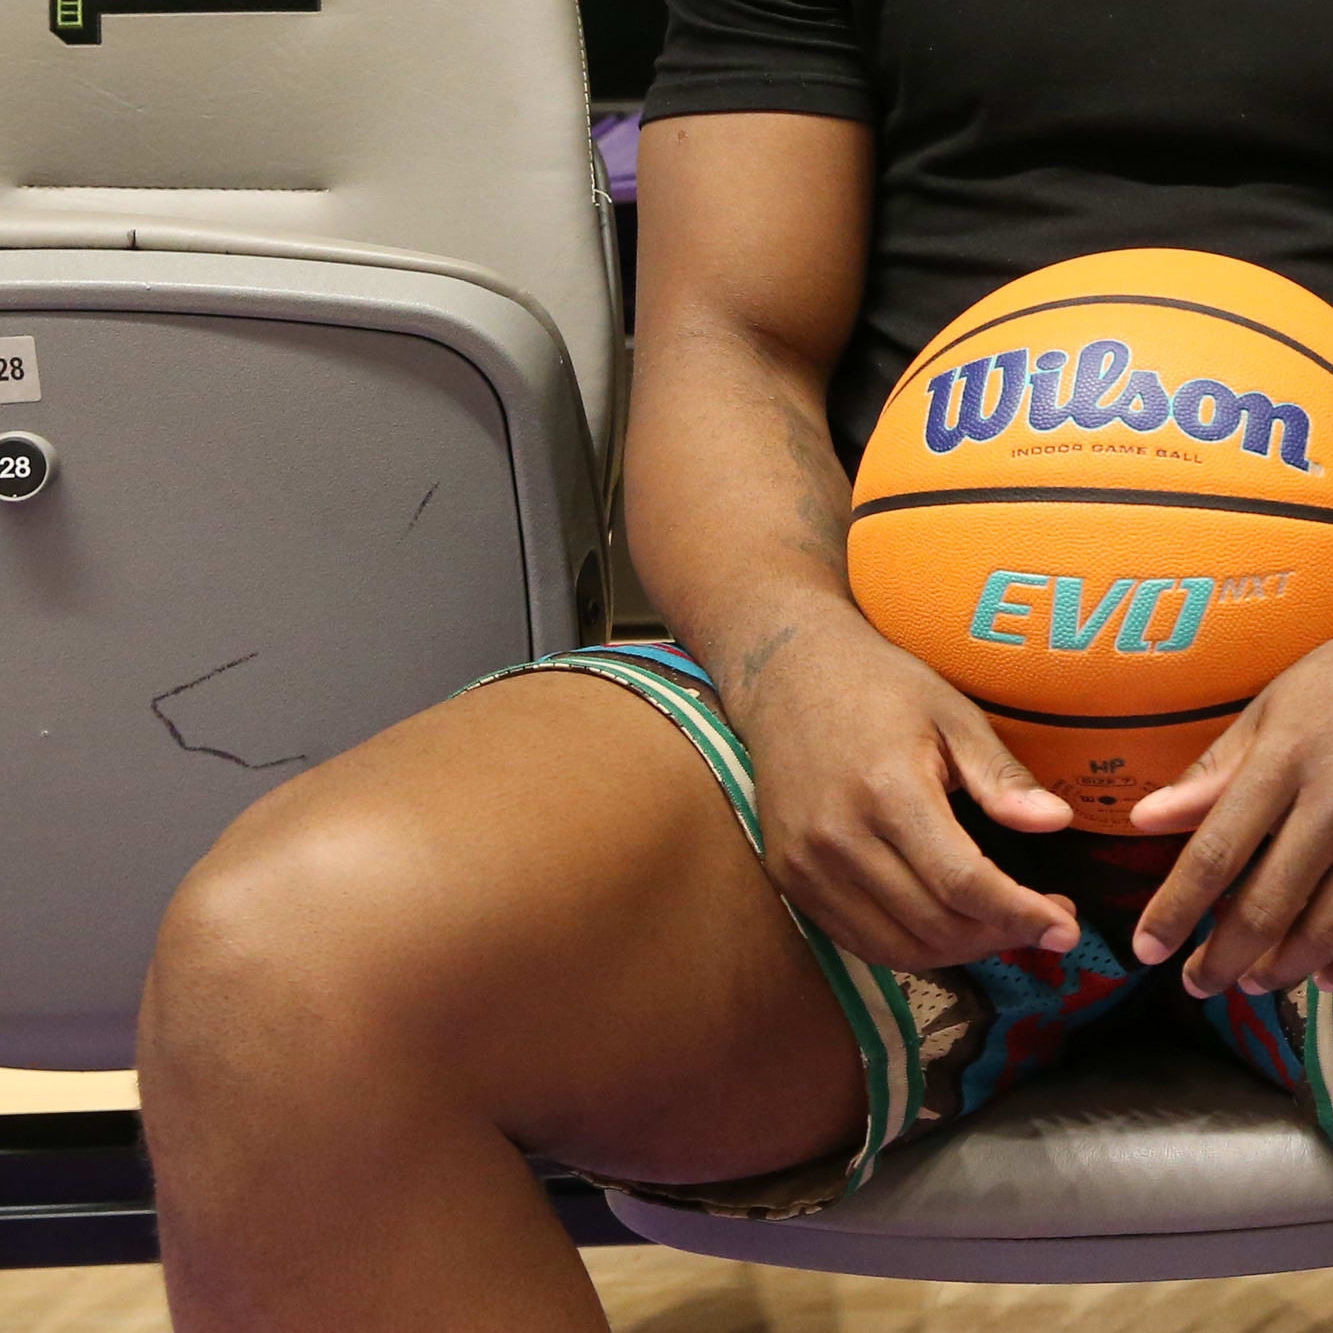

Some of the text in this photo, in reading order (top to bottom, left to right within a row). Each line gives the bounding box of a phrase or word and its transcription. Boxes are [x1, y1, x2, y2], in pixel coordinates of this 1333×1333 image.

[0, 356, 26, 382] 28
[925, 339, 1311, 473] Wilson
[0, 455, 32, 479] 28
[1011, 444, 1204, 464] INDOOR GAME BALL
[968, 569, 1296, 654] EVO NXT
